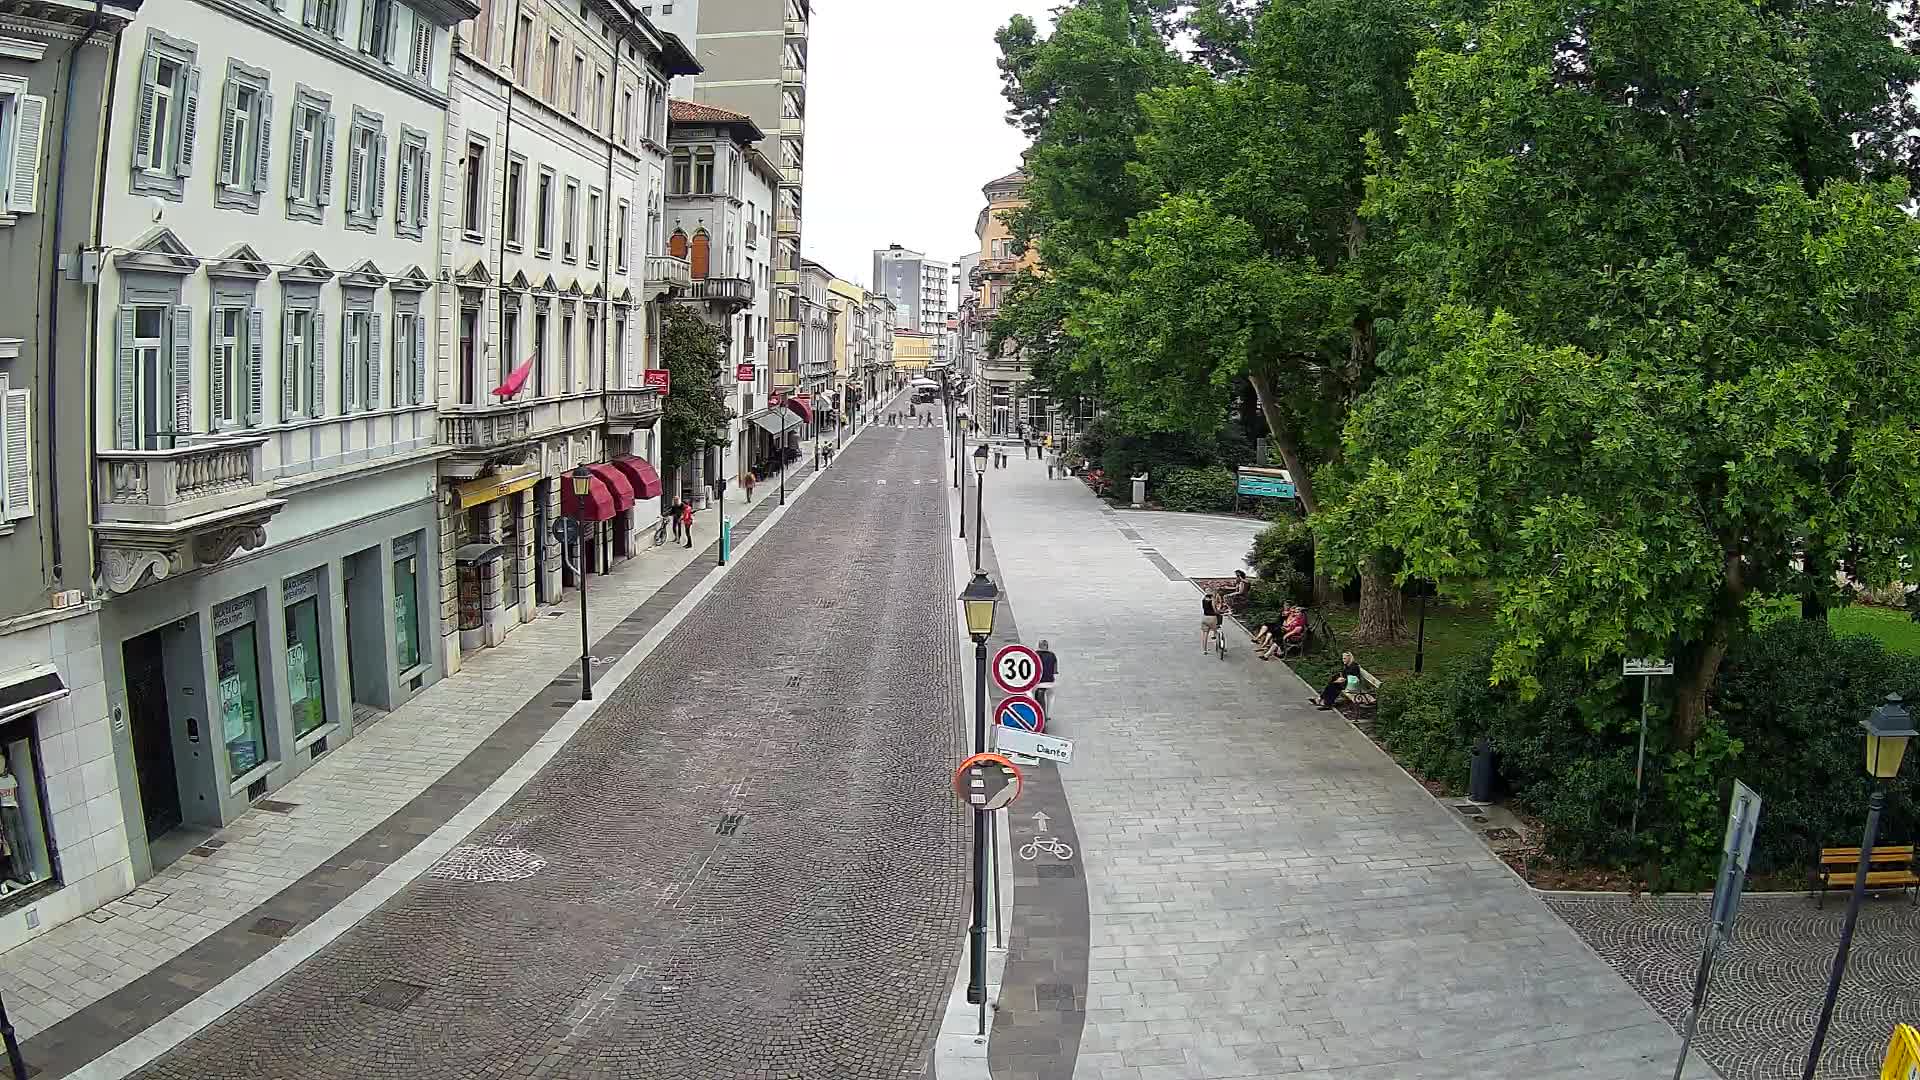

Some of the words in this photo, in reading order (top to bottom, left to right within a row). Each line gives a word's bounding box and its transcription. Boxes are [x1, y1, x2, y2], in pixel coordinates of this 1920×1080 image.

[1004, 659, 1031, 680] 30
[221, 679, 239, 699] 130
[1036, 743, 1067, 757] Dante
